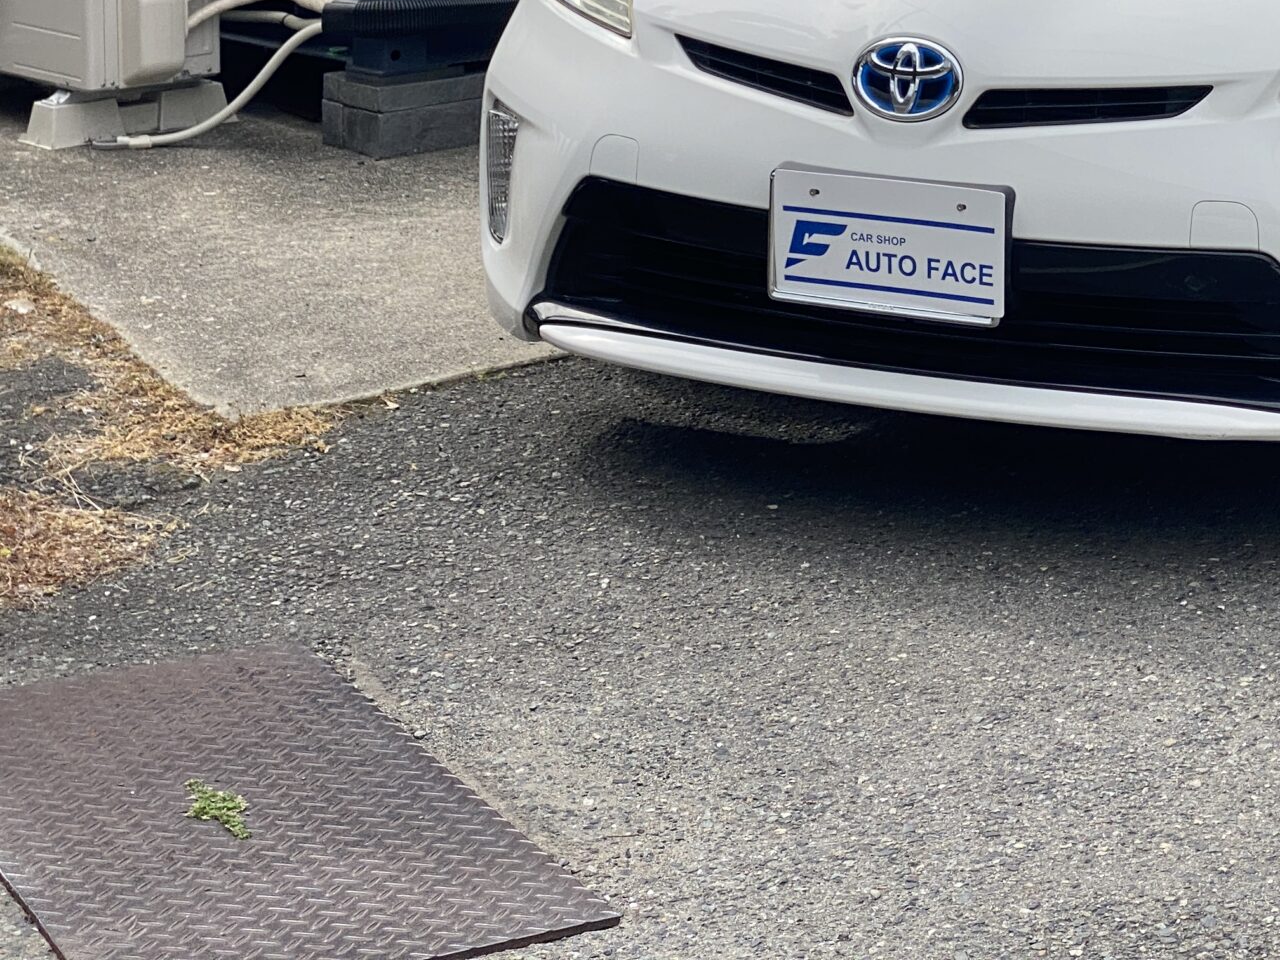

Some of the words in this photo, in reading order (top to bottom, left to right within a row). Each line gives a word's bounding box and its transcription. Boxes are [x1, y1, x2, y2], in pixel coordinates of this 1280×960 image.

[851, 232, 873, 243] CAR
[876, 235, 906, 247] SHOP
[845, 249, 917, 277] AUTO
[926, 258, 994, 287] FACE
